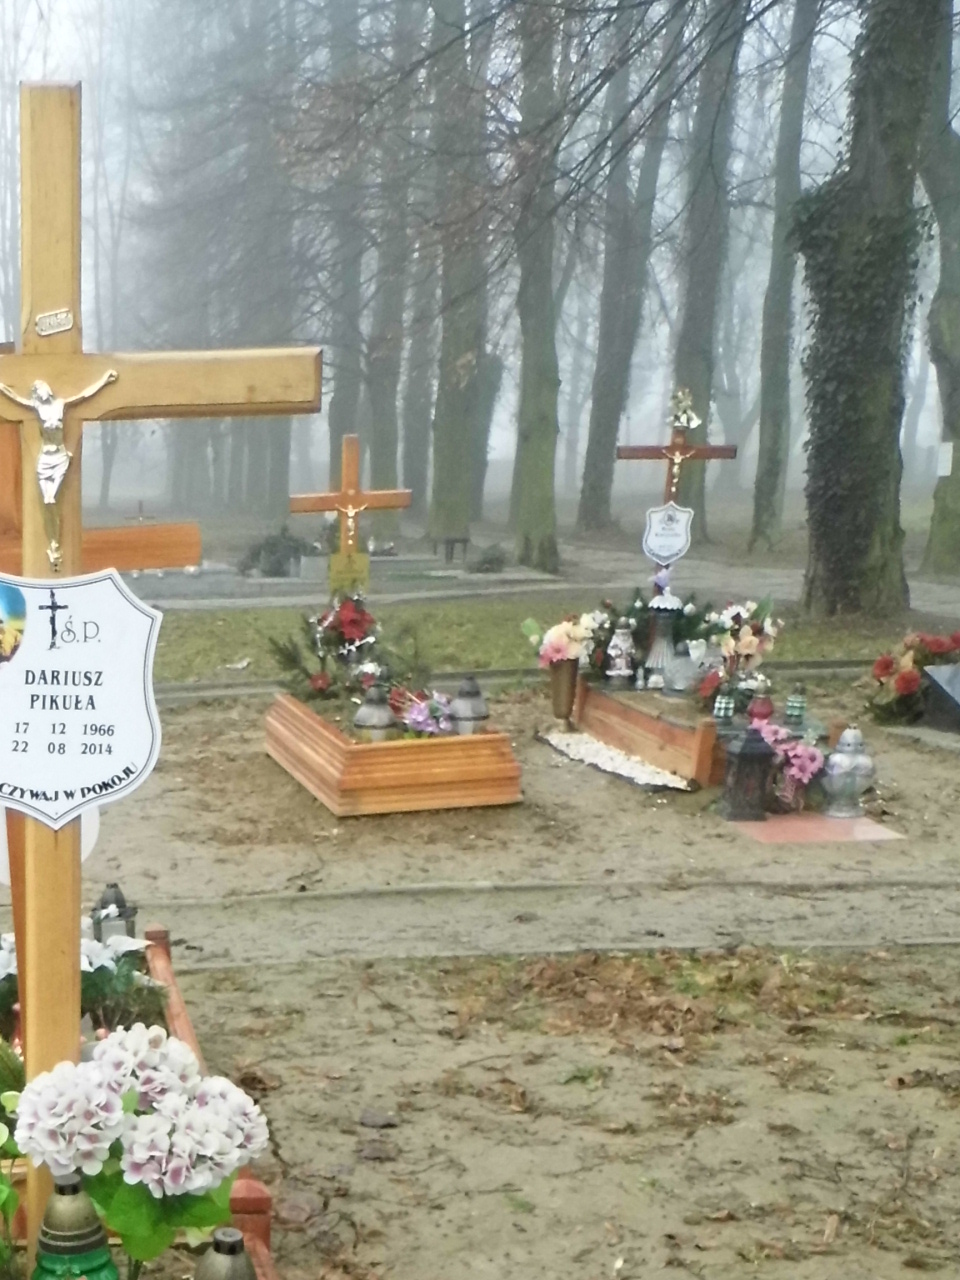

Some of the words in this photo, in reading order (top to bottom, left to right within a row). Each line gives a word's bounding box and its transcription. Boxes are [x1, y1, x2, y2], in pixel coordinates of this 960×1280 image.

[24, 670, 104, 687] DARIUSZ
[30, 694, 96, 711] PIKUŁA
[14, 722, 29, 735] 17
[51, 723, 66, 735] 12
[82, 723, 115, 737] 1966
[11, 740, 29, 753] 22
[47, 742, 66, 755] 08
[81, 743, 113, 756] 2014
[63, 789, 77, 800] W
[80, 761, 139, 799] POKOJU
